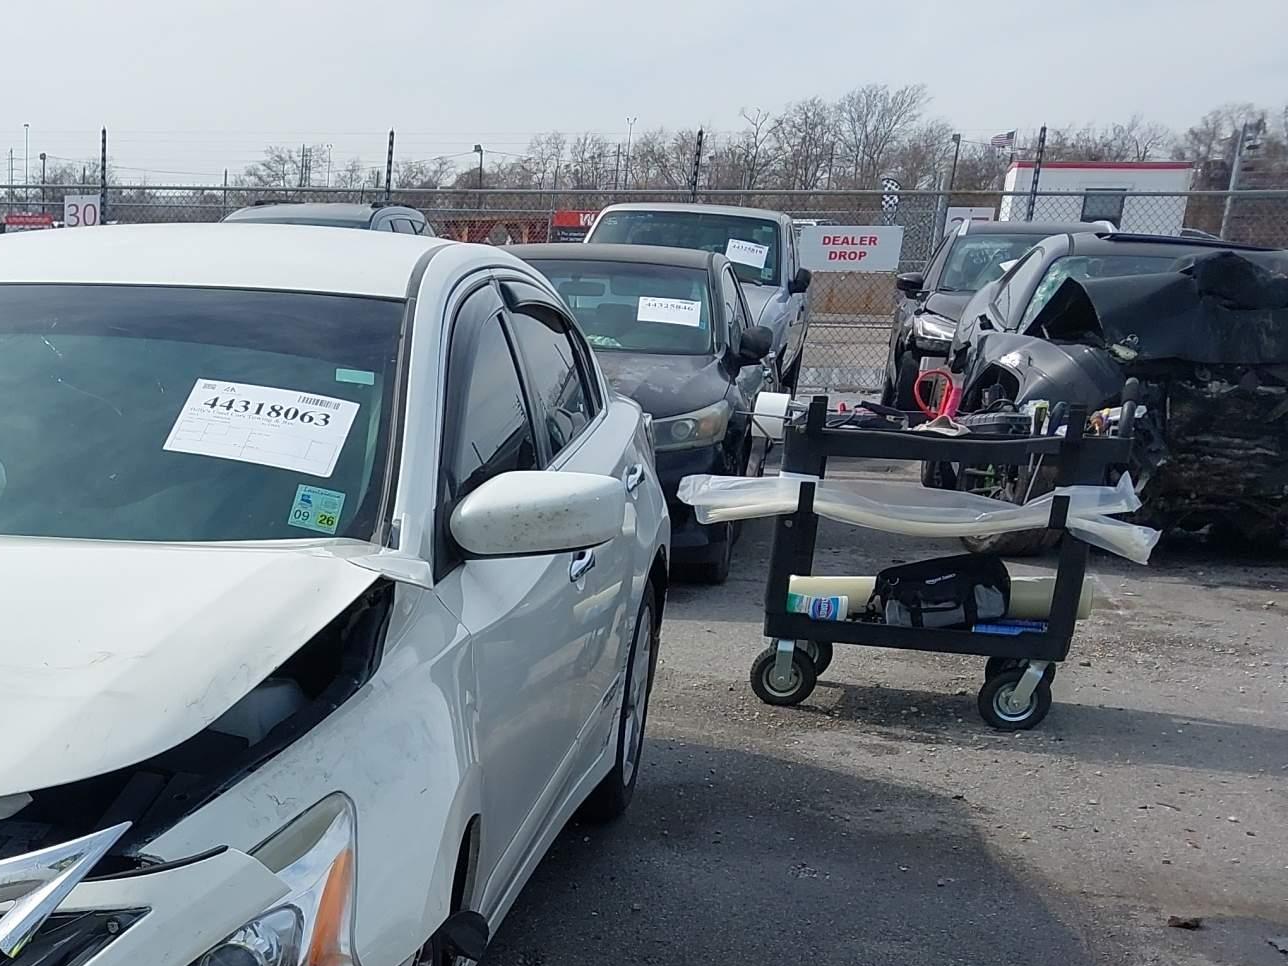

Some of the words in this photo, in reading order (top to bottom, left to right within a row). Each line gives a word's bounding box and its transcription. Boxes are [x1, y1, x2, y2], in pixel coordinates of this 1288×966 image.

[67, 203, 97, 227] 30
[822, 235, 878, 246] DEALER
[828, 251, 867, 261] DROP
[203, 396, 331, 427] 44318063
[294, 509, 310, 521] 09
[318, 514, 335, 526] 26
